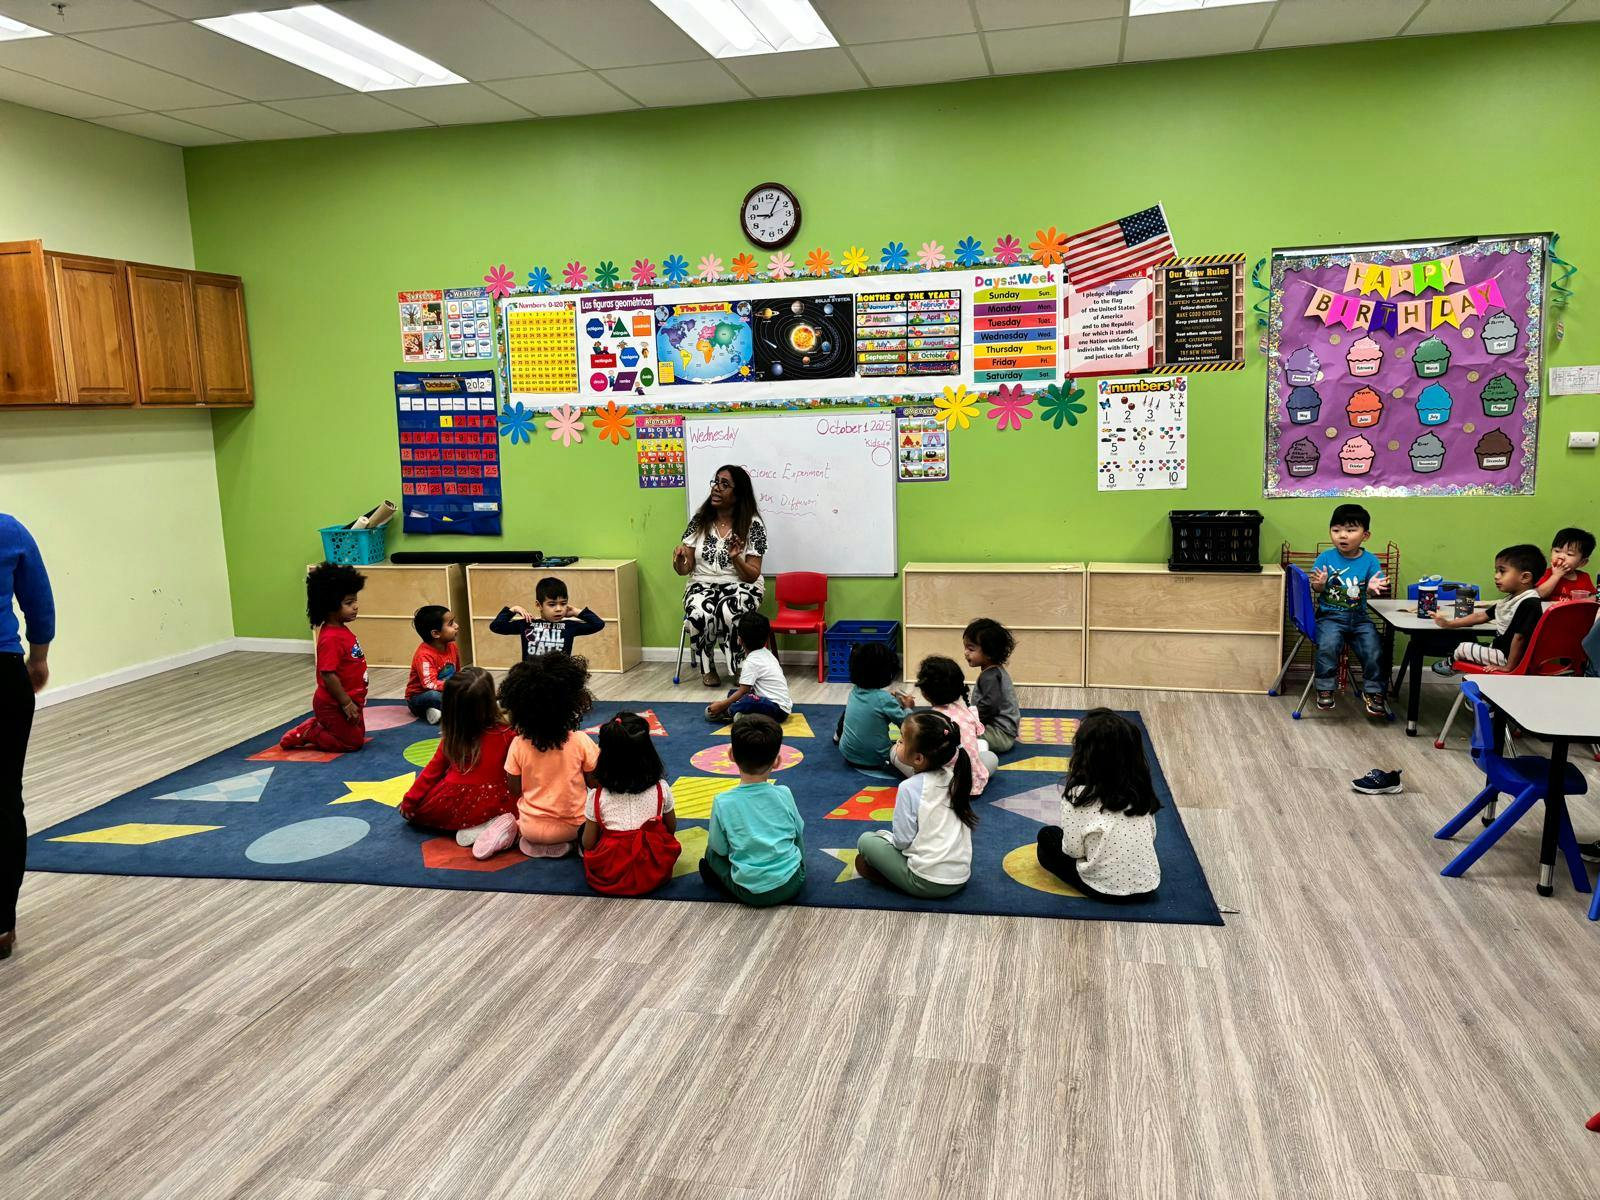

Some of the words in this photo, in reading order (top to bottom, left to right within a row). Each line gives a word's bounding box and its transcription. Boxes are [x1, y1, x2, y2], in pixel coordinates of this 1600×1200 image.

[1169, 270, 1182, 278] Our
[1185, 269, 1204, 278] Crew
[1206, 268, 1229, 276] Rules
[1355, 259, 1454, 287] HAPPY
[975, 276, 1007, 288] Days
[1017, 271, 1054, 284] Week
[989, 291, 1020, 299] Sunday
[582, 300, 592, 310] Las
[593, 299, 614, 311] figuras
[615, 296, 652, 310] geométricas
[988, 304, 1021, 313] Monday
[1316, 284, 1491, 325] BIRTHDAY
[988, 318, 1021, 327] Tuesday
[980, 331, 1028, 340] Wednesday
[986, 345, 1023, 354] Thursday
[992, 358, 1017, 366] Friday
[986, 372, 1023, 380] Saturday
[1111, 380, 1171, 394] numbers
[1125, 410, 1131, 420] 2
[1147, 409, 1153, 419] 3
[1175, 408, 1181, 418] 4
[458, 417, 463, 425] 2
[816, 418, 863, 435] October
[870, 420, 891, 432] 2025
[689, 426, 739, 444] Wednesday
[1111, 443, 1117, 452] 5
[1139, 442, 1145, 451] 6
[1169, 441, 1176, 450] 7
[486, 467, 497, 475] 25
[740, 464, 777, 479] Science
[782, 462, 831, 482] Experiment
[1108, 474, 1115, 484] 8
[1138, 473, 1144, 483] 9
[1169, 472, 1178, 482] 10
[417, 484, 427, 493] 27
[431, 485, 440, 493] 28
[460, 485, 468, 493] 30
[473, 485, 481, 493] 31
[534, 628, 564, 643] TAIL
[528, 642, 564, 655] GATE
